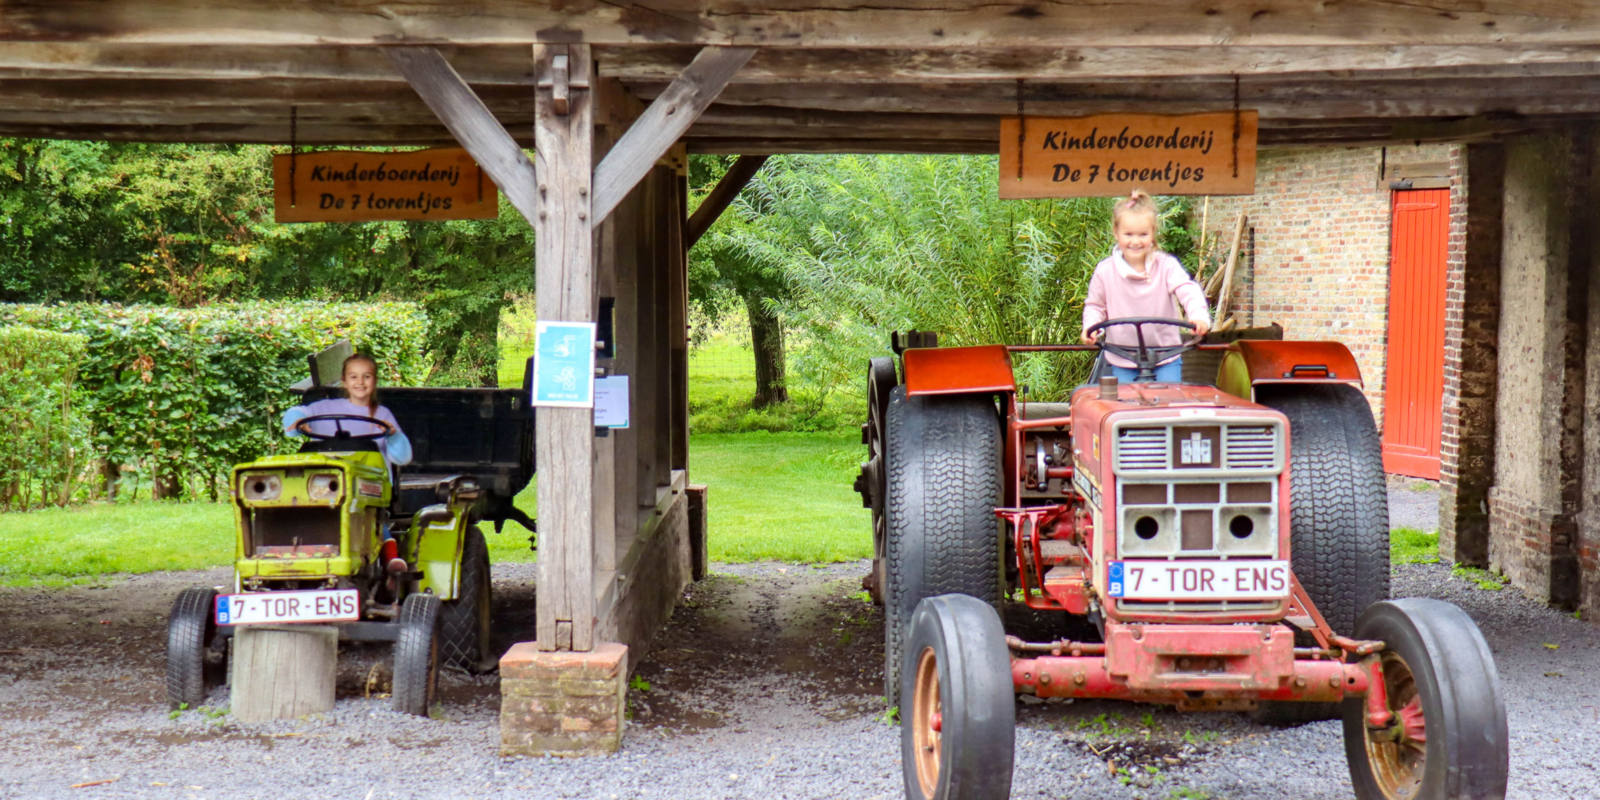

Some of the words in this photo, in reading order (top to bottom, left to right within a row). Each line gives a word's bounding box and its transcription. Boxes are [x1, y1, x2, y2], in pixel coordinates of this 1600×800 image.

[1042, 126, 1213, 154] Kinderboerderij
[311, 162, 460, 186] Kinderboerderij
[1052, 163, 1081, 182] De
[1088, 164, 1100, 184] 7
[1107, 160, 1204, 187] torentjes
[319, 193, 344, 209] De
[351, 193, 361, 210] 7
[367, 192, 452, 214] torentjes
[1110, 582, 1122, 594] B
[219, 612, 229, 622] B
